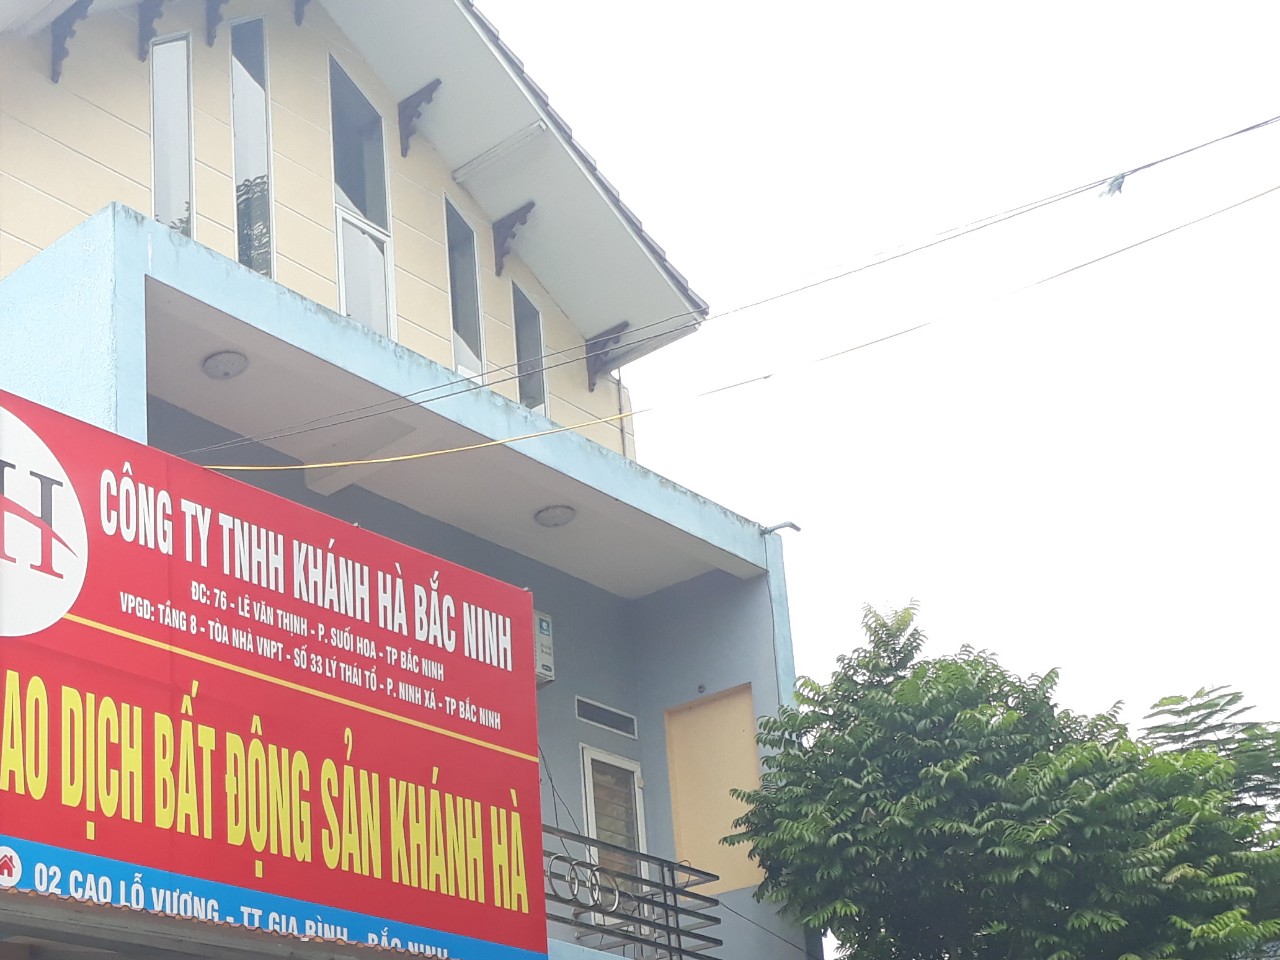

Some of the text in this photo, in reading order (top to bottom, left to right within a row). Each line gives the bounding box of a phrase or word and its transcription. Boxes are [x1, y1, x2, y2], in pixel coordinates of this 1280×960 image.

[100, 461, 512, 671] CÔNG TY TNHH KHÁNH HÀ BẮC NINH
[191, 581, 444, 682] ĐC: 76 LÊ VĂN THỊNH P. SUỐI HOA TP BẮC NINH
[120, 591, 501, 730] VPGD: TẦNG 8 TÒA NHÀ VNPT SỐ 33 LÝ THÁI TỔ P. NINH XÁ TP BẮC NINH
[61, 685, 143, 841] DỊCH
[155, 680, 216, 839] BẤT
[225, 714, 312, 879] ĐỘNG
[320, 727, 381, 879] SẢN
[389, 767, 484, 905] KHÁNH
[493, 789, 529, 915] HÀ
[34, 862, 62, 895] 02
[70, 870, 113, 903] CAO
[120, 872, 145, 910] LỖ
[151, 887, 220, 922] VƯƠNG
[240, 906, 263, 928] TT
[268, 912, 299, 936] GIA
